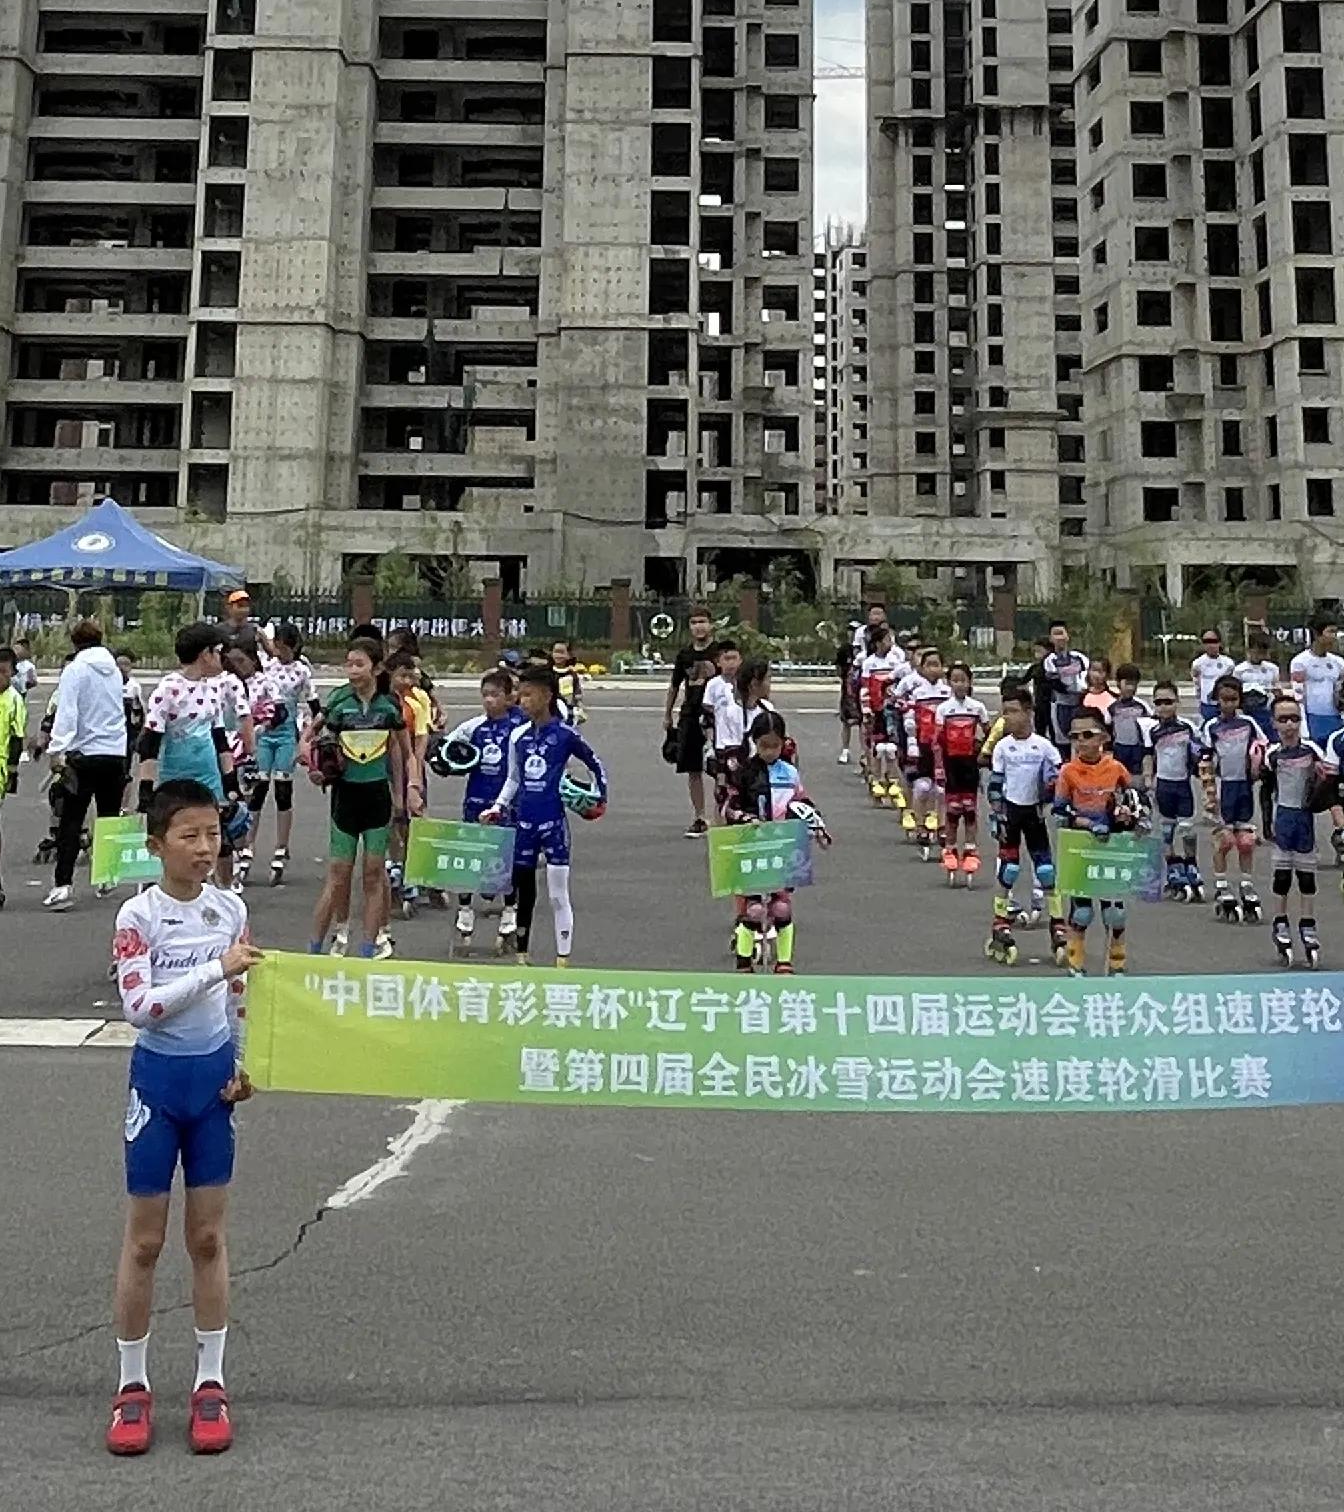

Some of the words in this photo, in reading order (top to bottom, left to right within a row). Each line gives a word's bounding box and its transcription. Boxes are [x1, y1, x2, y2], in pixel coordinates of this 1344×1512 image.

[519, 1047, 1272, 1101] 暨第四届全民冰雪运动会速度轮滑比赛
